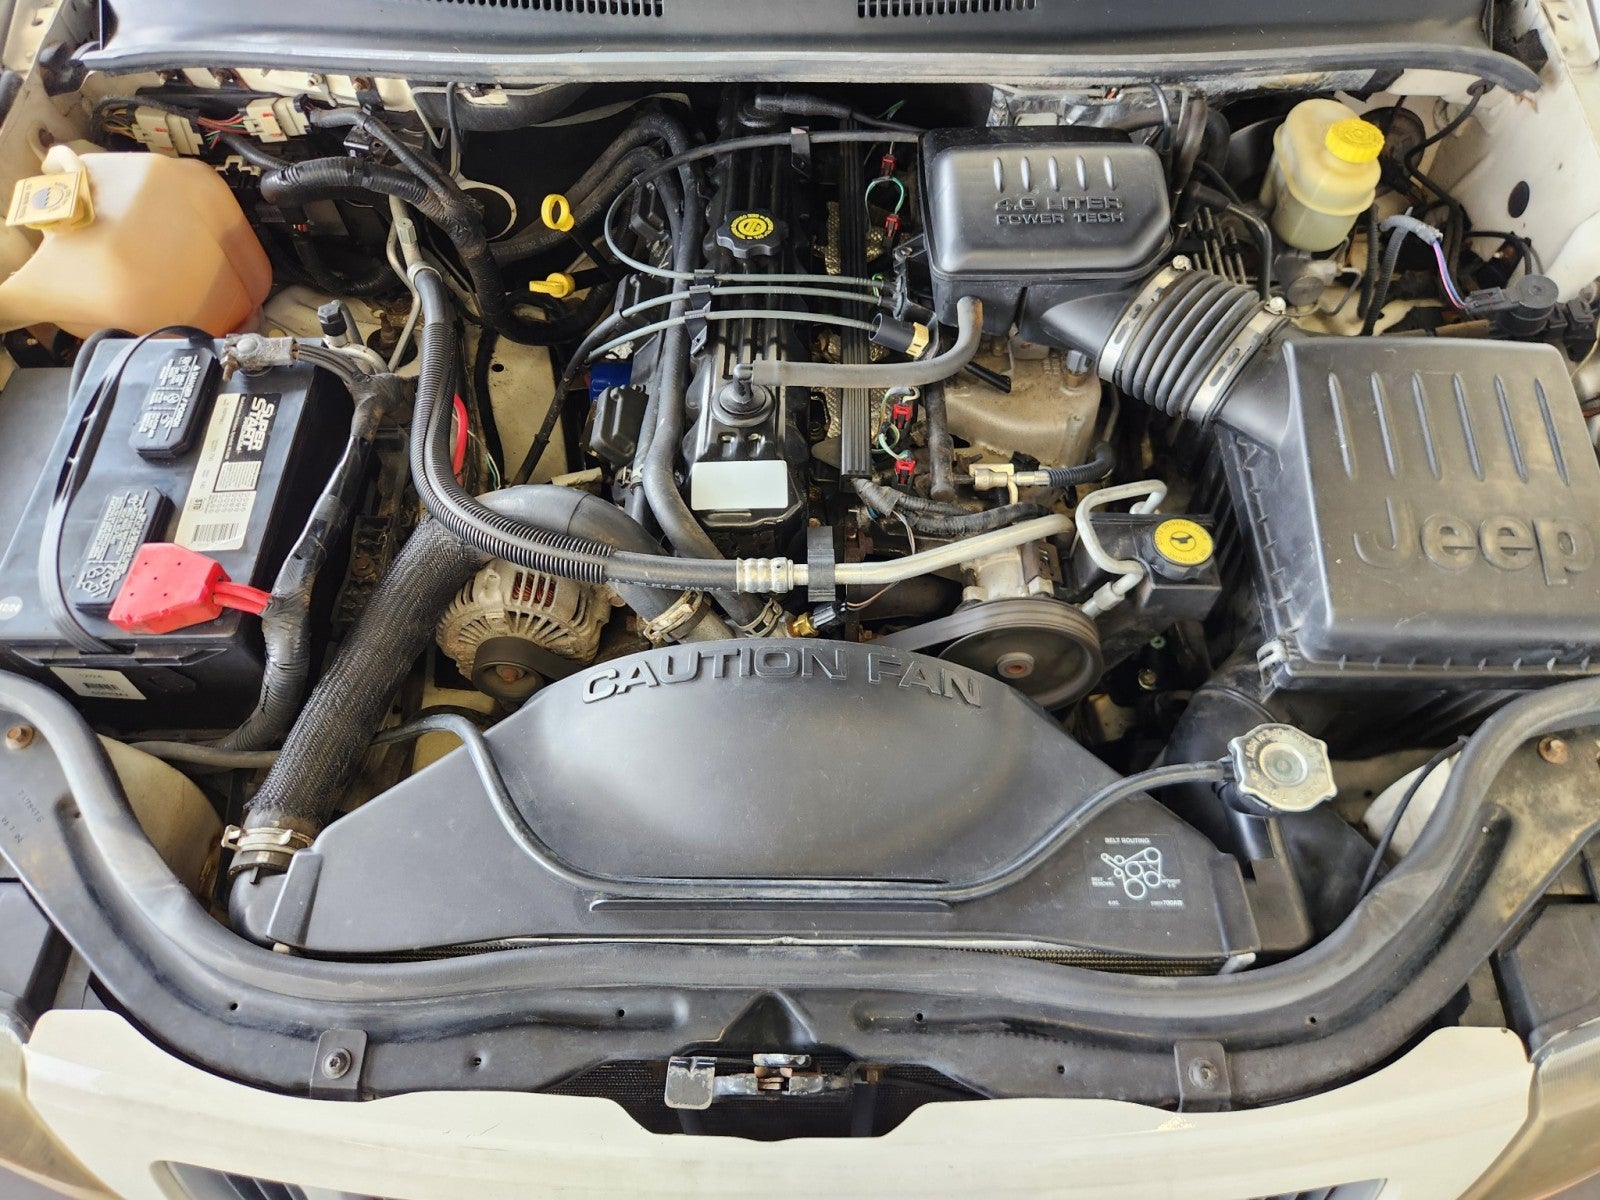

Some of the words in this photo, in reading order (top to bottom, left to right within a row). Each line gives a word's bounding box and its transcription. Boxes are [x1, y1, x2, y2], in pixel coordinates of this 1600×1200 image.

[995, 197, 1036, 211] 4.0
[1046, 197, 1123, 210] LITER
[996, 213, 1065, 225] POWER
[1073, 212, 1125, 223] TECH
[241, 396, 267, 451] START
[251, 403, 275, 451] SUPER
[1353, 497, 1595, 587] Jeep
[581, 645, 848, 703] CAUTION
[868, 651, 982, 708] FAN
